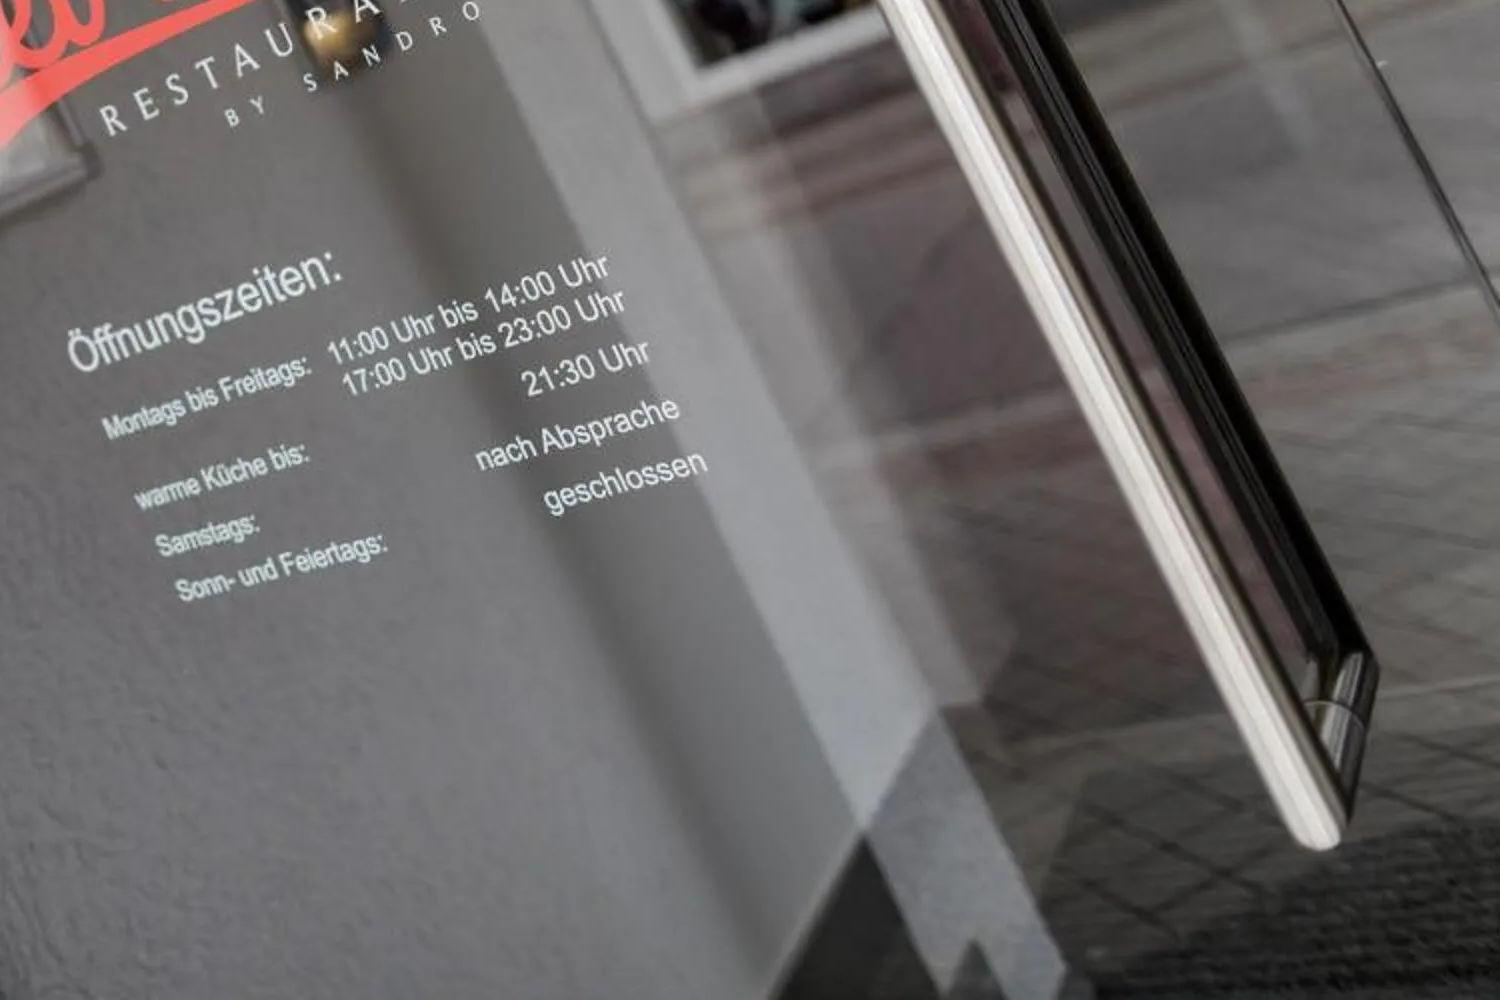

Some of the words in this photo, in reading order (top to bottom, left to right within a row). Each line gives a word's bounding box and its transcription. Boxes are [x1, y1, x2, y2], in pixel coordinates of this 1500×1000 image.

[224, 96, 265, 128] BY
[303, 1, 480, 92] SANDRO
[67, 252, 343, 373] Öffnungszeiten:
[101, 397, 186, 440] Montags
[185, 387, 219, 414] bis
[219, 356, 312, 402] Freitags:
[327, 325, 389, 365] 11:00
[390, 312, 435, 344] Uhr
[437, 299, 478, 330] bis
[484, 271, 556, 313] 14:00
[558, 255, 609, 288] Uhr
[342, 356, 406, 397] 17:00
[408, 342, 453, 376] Uhr
[455, 331, 497, 361] bis
[497, 304, 571, 349] 23:00
[573, 289, 626, 322] Uhr
[133, 474, 201, 511] warme
[201, 455, 269, 491] Küche
[268, 443, 310, 470] bis:
[520, 353, 596, 398] 21:30
[598, 340, 651, 374] Uhr
[154, 514, 260, 557] Samstags:
[474, 435, 537, 471] nach
[540, 398, 681, 455] Absprache
[174, 573, 237, 603] Sonn-
[238, 558, 279, 588] und
[279, 533, 389, 578] Feiertags:
[543, 452, 708, 517] geschlossen
